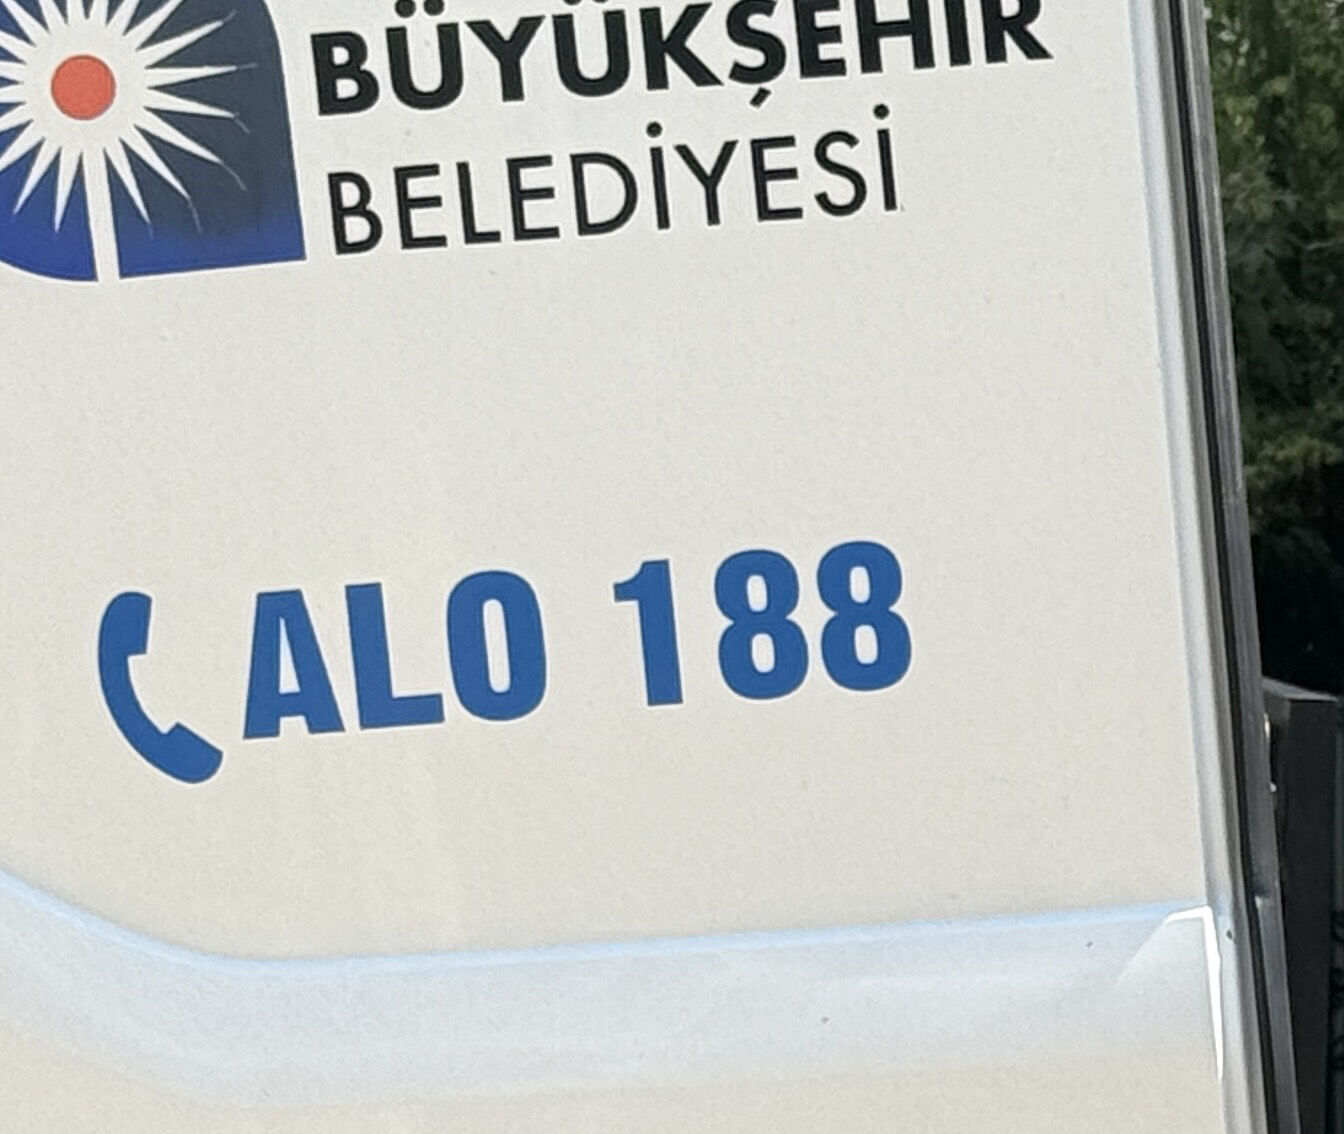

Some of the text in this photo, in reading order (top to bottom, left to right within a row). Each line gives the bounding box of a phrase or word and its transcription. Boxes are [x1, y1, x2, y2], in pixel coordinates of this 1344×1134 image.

[327, 103, 899, 256] BELEDİYESİ
[243, 540, 912, 740] ALO 188
